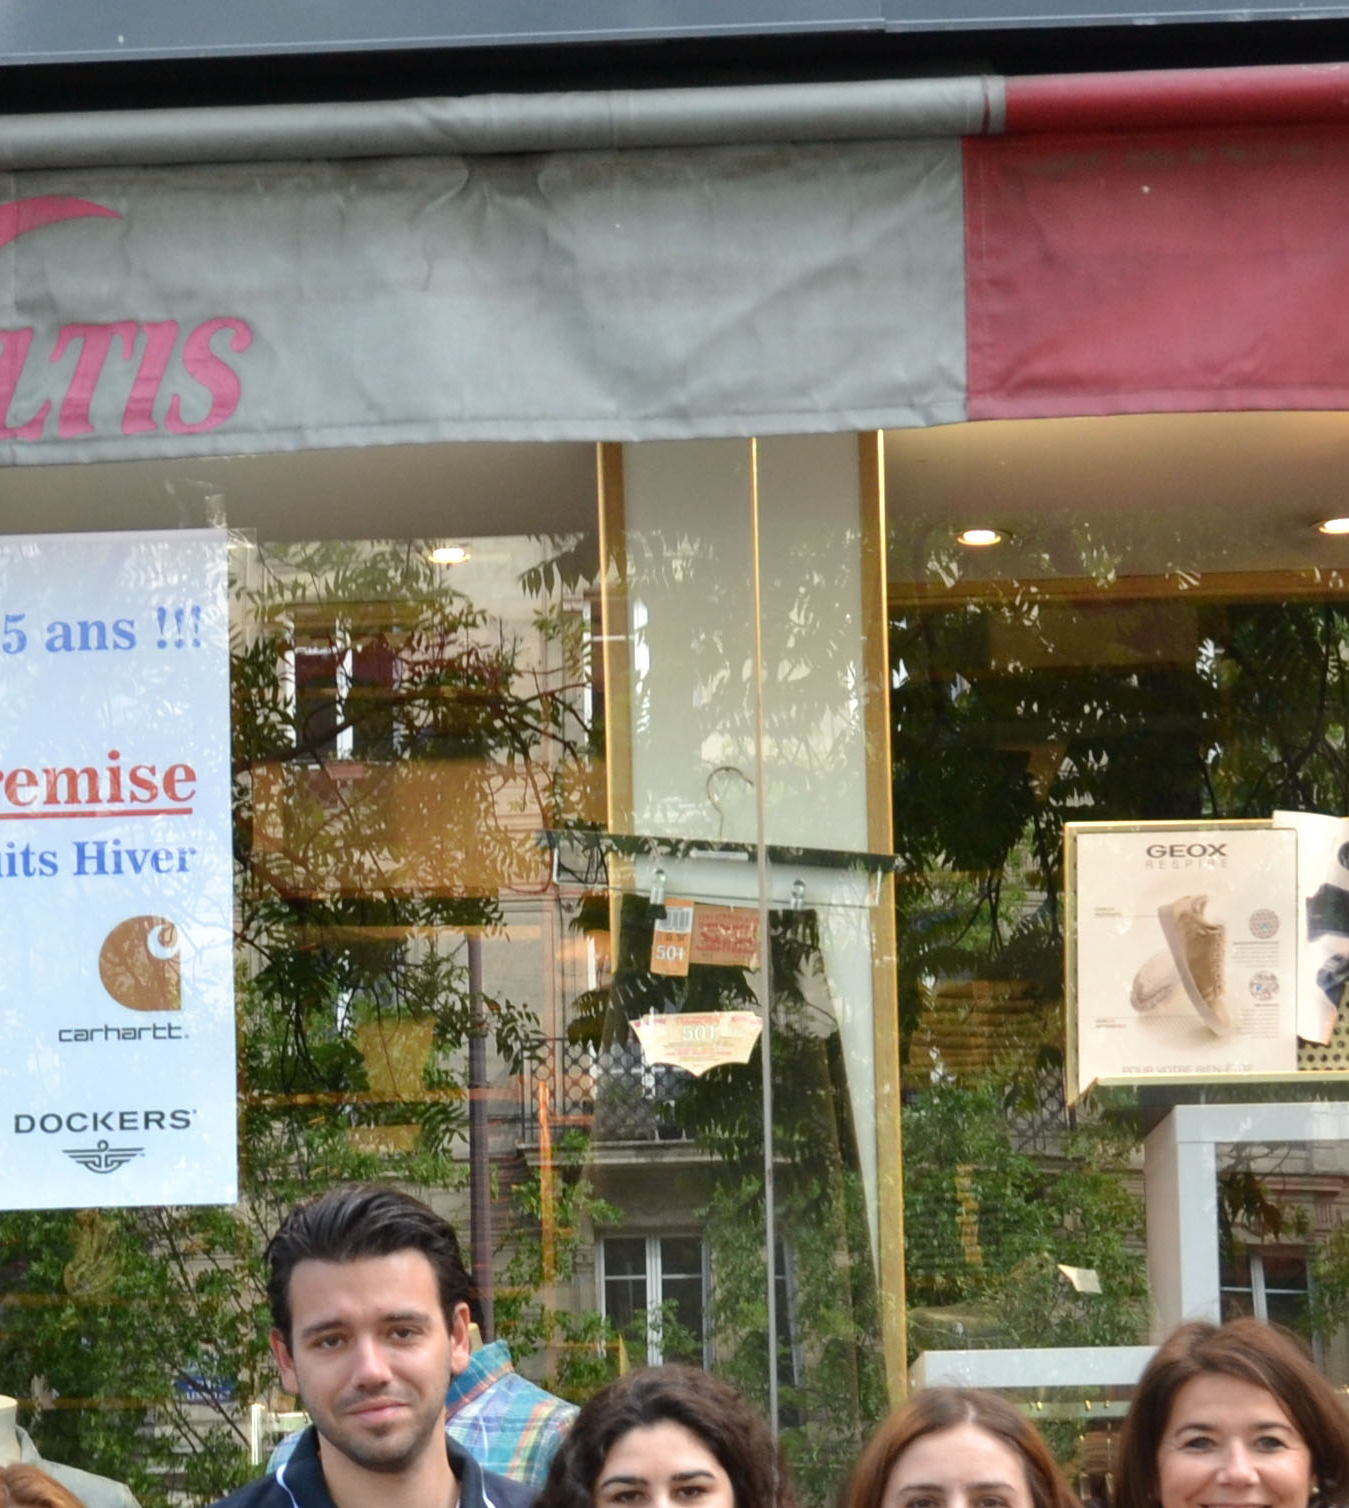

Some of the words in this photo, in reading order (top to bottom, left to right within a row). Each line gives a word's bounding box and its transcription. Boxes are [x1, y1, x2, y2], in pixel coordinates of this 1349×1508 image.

[45, 618, 136, 653] ans
[156, 605, 202, 650] !!!
[73, 837, 197, 877] Hiver
[1146, 843, 1227, 858] GEOX
[655, 945, 686, 961] 501
[58, 1022, 183, 1042] carhartt
[14, 1108, 192, 1134] DOCKERS
